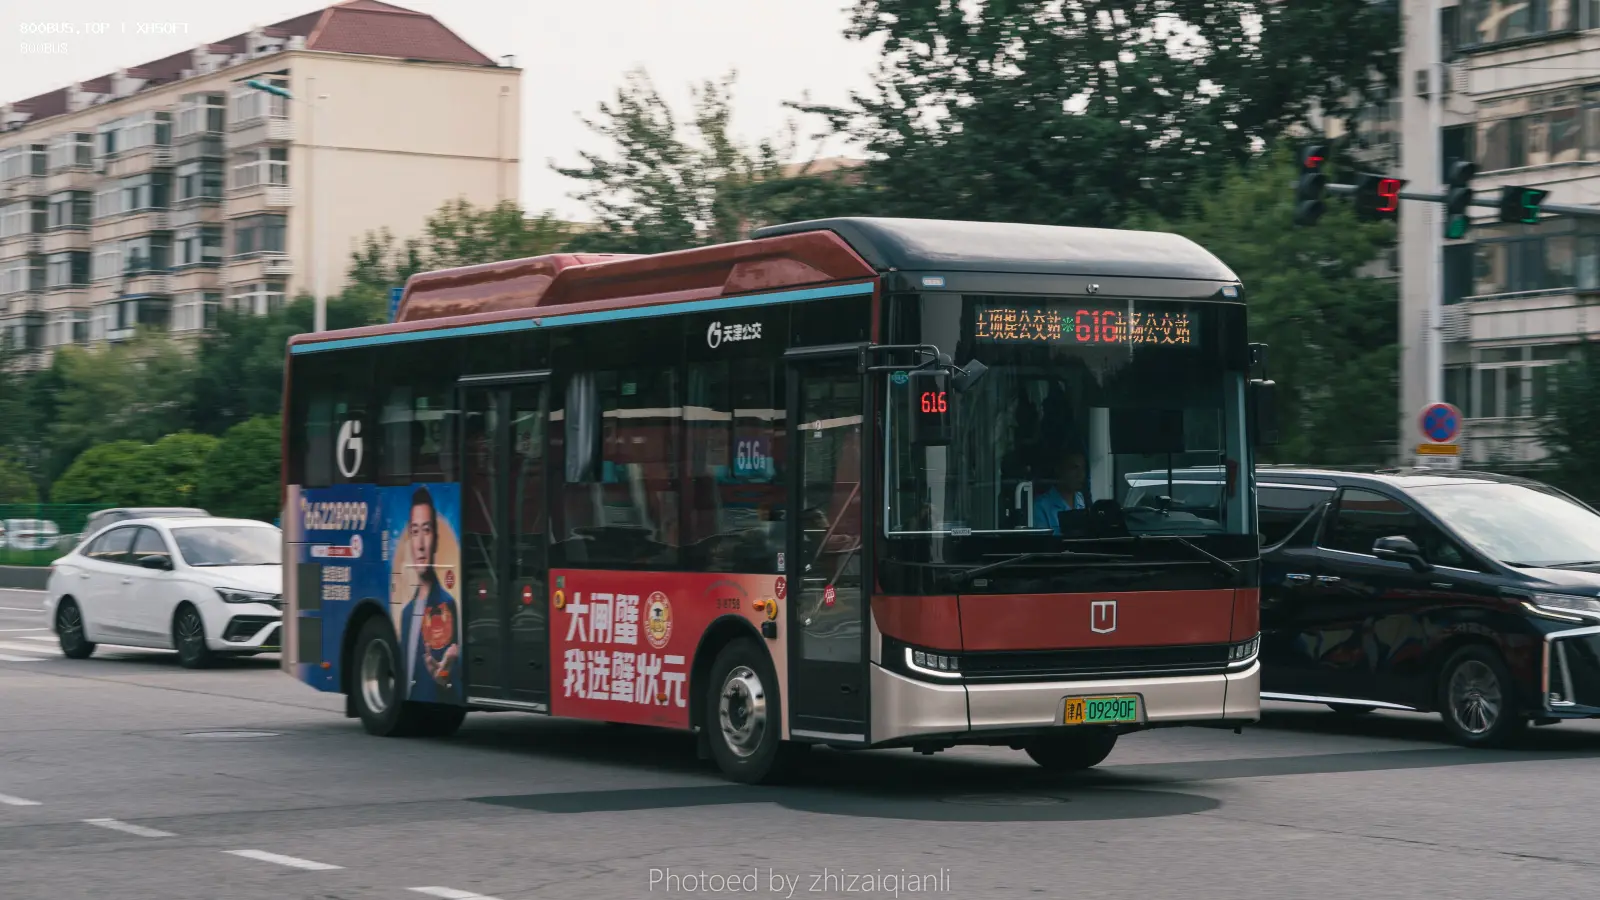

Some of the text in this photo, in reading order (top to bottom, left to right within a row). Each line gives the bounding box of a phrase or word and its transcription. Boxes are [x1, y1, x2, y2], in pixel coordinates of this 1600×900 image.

[1377, 179, 1400, 212] 9
[723, 322, 761, 342] 天津公交
[1075, 309, 1116, 343] 616
[921, 391, 947, 413] 616
[565, 591, 640, 645] 大闸蟹
[563, 649, 686, 707] 我选蟹状元
